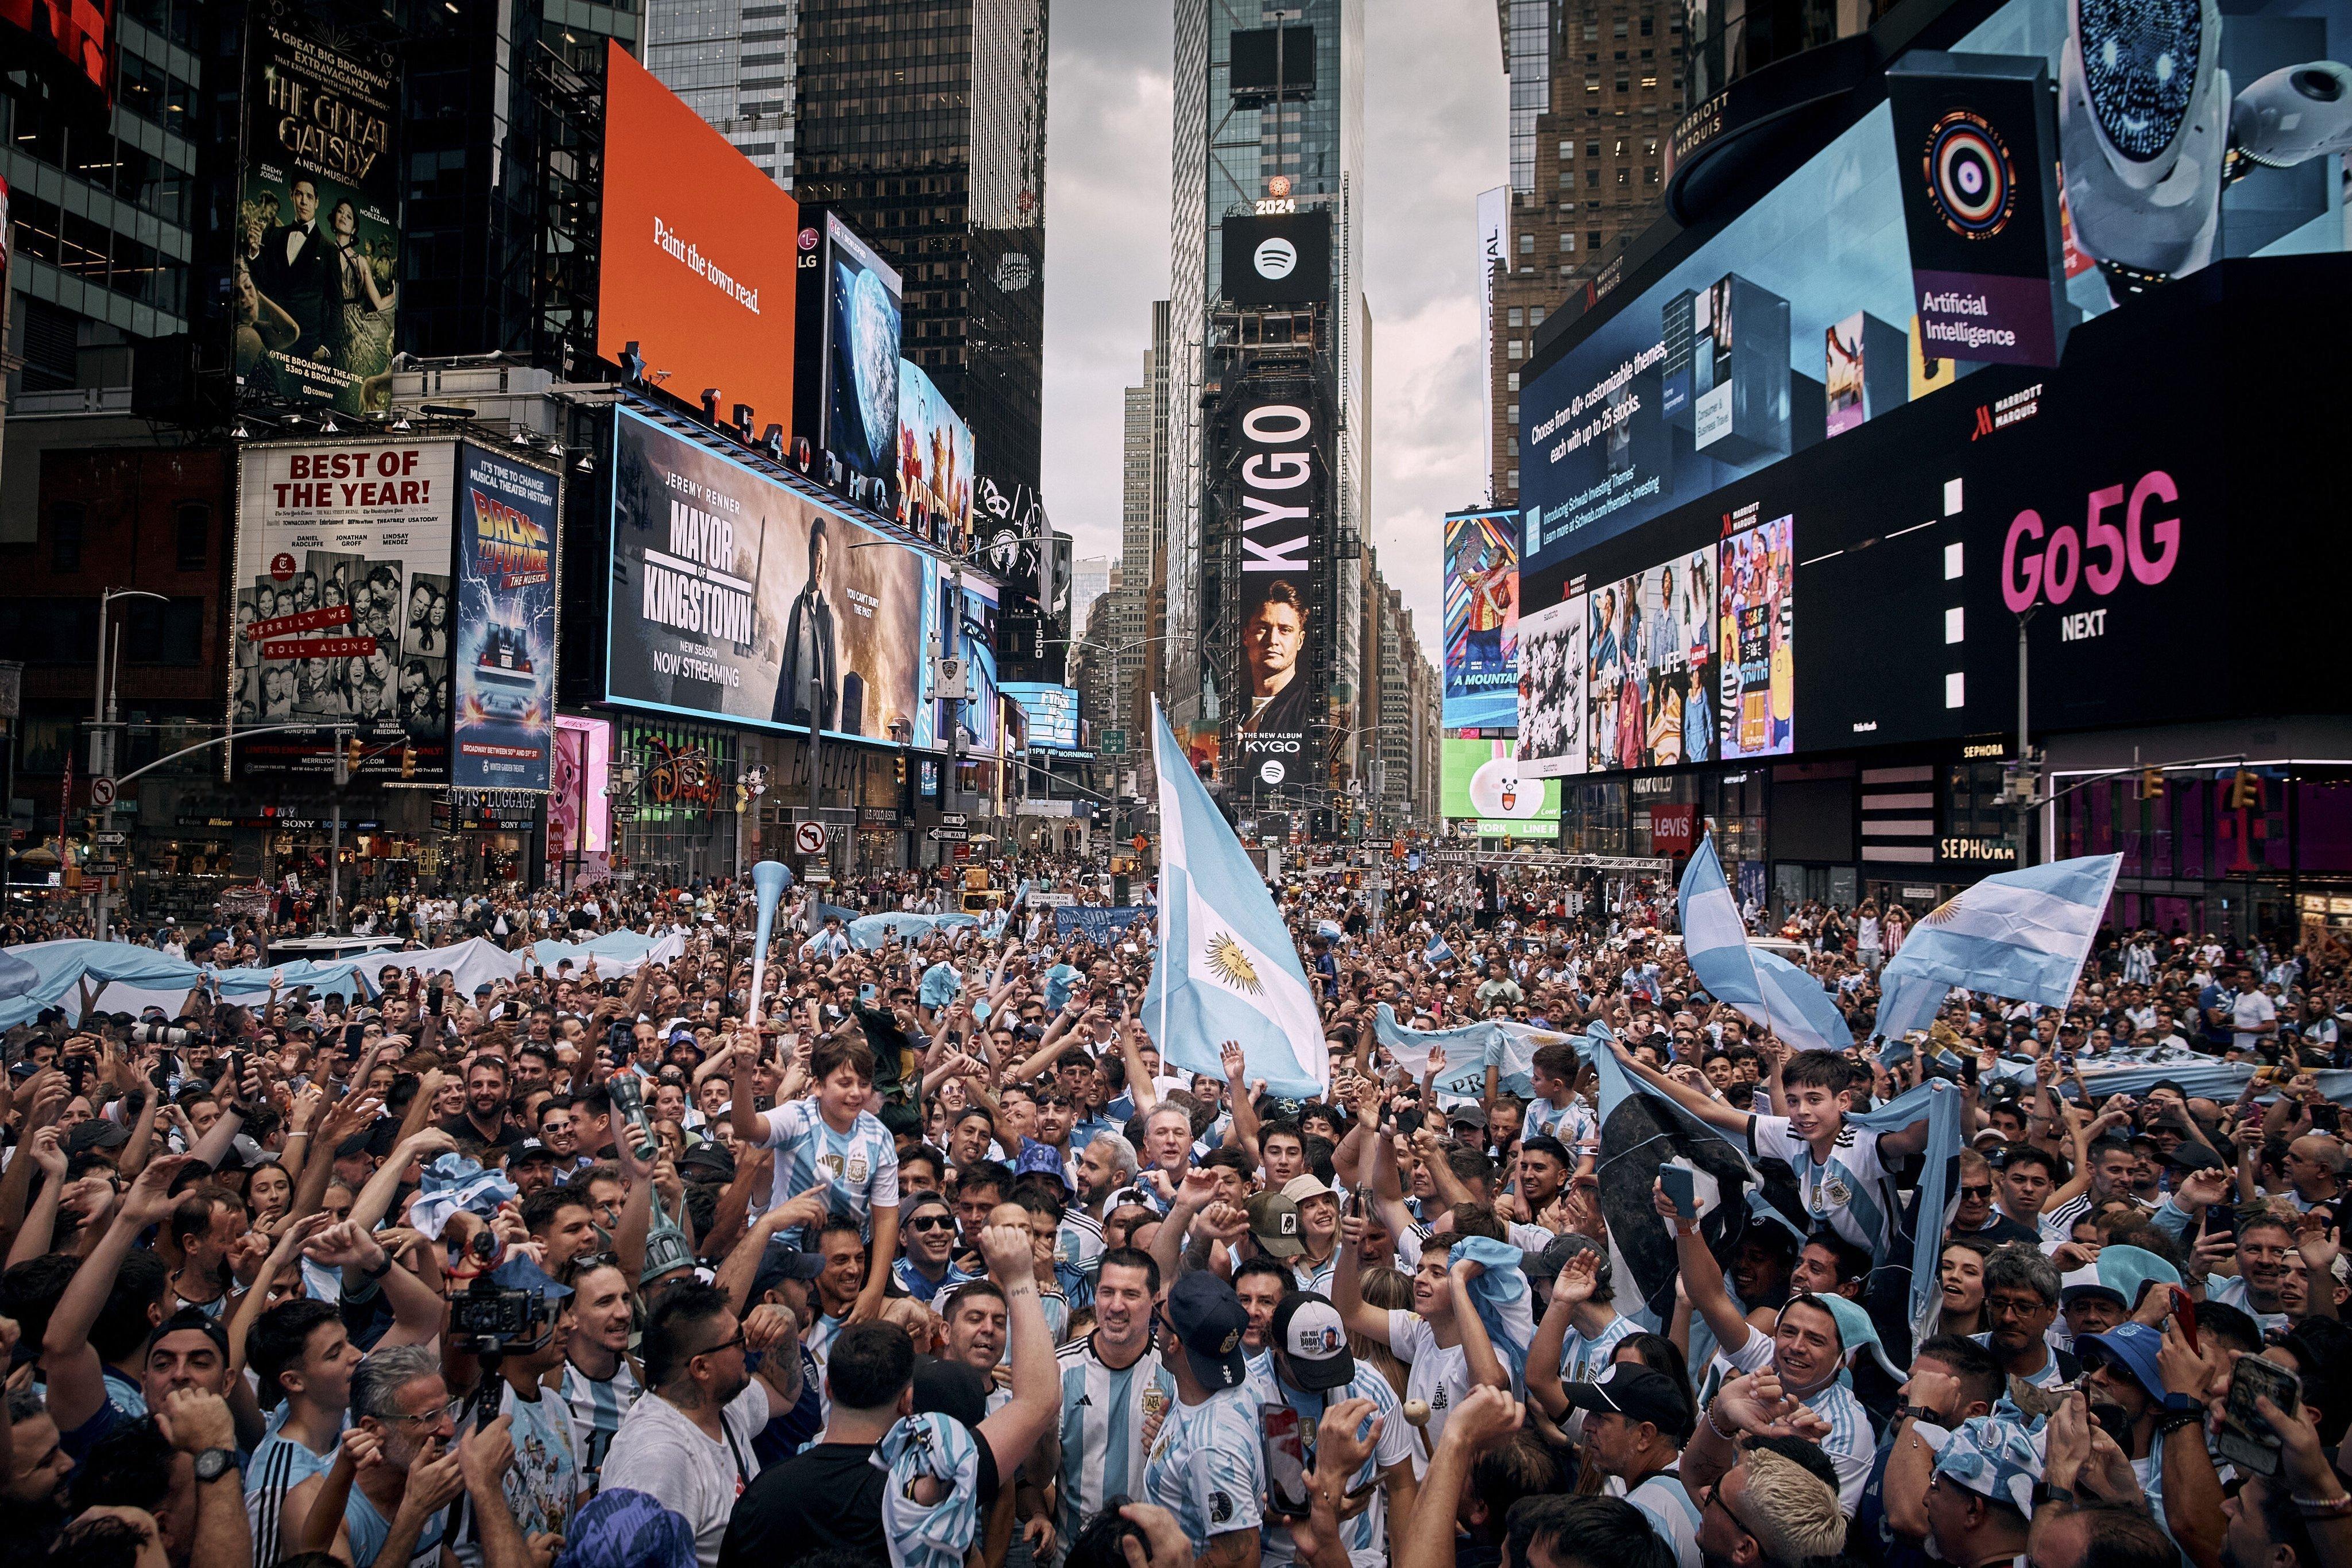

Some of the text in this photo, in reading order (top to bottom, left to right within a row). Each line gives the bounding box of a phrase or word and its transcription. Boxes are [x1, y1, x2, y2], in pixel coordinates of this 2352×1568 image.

[274, 55, 289, 66] THAT
[291, 61, 322, 82] EXPLODES
[323, 77, 338, 88] WITH
[339, 84, 351, 94] LIFE
[352, 91, 363, 100] AND
[295, 51, 370, 94] EXTRAVAGANZA
[318, 48, 389, 90] BIG BROADWAY
[269, 76, 388, 154] THE GREAT
[1676, 91, 1729, 141] MARRIOTT
[279, 117, 376, 179] GATSBY
[1676, 117, 1721, 160] MARQUIS
[260, 164, 283, 176] JEREMY
[260, 171, 283, 184] JORDAN
[295, 157, 359, 189] A NEW MUSICAL
[359, 209, 390, 224] NOBLEZADA
[370, 206, 380, 215] EVA
[1255, 199, 1296, 215] 2024
[653, 216, 760, 315] Paint the town read.
[798, 255, 817, 268] LG
[1923, 291, 1989, 316] Artificial
[1926, 320, 2016, 348] Intelligence
[275, 351, 363, 384] THE BROADWAY THEATRE
[285, 363, 350, 388] 53RD & BROADWAY
[312, 389, 334, 400] COMPANY
[1531, 340, 1668, 445] Choose from 40+ customizable themes,
[1995, 384, 2042, 412] MARRIOTT
[1995, 401, 2037, 428] MARQUIS
[1550, 393, 1641, 464] each with up to 25 stocks.
[290, 451, 419, 479] BEST OF
[481, 460, 544, 491] IT’S TIME TO CHANGE
[273, 480, 431, 508] THE YEAR!
[470, 469, 553, 506] MUSICAL THEATER HISTORY
[665, 471, 740, 515] JEREMY RENNER
[1242, 405, 1312, 572] KYGO
[471, 488, 543, 547] BACK
[1733, 501, 1759, 520] MARRIOTT
[1733, 514, 1757, 531] MARQUIS
[478, 538, 495, 559] TO
[670, 499, 733, 573] MAYOR
[2002, 470, 2180, 613] Go5G
[492, 541, 548, 575] FUTURE
[510, 574, 547, 586] THE MUSICAL
[697, 565, 706, 579] OF
[643, 563, 752, 645] KINGSTOWN
[846, 587, 879, 609] YOU BURY
[248, 609, 346, 638] MERRILY WE
[853, 603, 872, 619] THE PAST
[2062, 609, 2107, 642] NEXT
[268, 642, 369, 655] ROLL ALONG
[680, 640, 717, 659] NEW SEASON
[653, 651, 740, 688] NOW STREAMING
[1453, 675, 1463, 686] A
[1597, 651, 1680, 690] TOPS FOR LIFE
[463, 745, 487, 753] BROADWAY
[487, 746, 508, 755] BETWEEN
[1245, 741, 1301, 753] KYGO
[1964, 744, 2004, 758] SEPHORA
[488, 791, 536, 809] LUGGAGE
[208, 818, 233, 826] Nikon
[276, 808, 296, 818] NY
[281, 820, 315, 828] SONY
[463, 820, 478, 828] Nikon
[501, 821, 518, 829] SONY
[872, 810, 885, 820] POLO
[550, 831, 563, 842] MINI
[1477, 823, 1547, 834] YORK LINE
[1301, 1337, 1320, 1346] BOBO?
